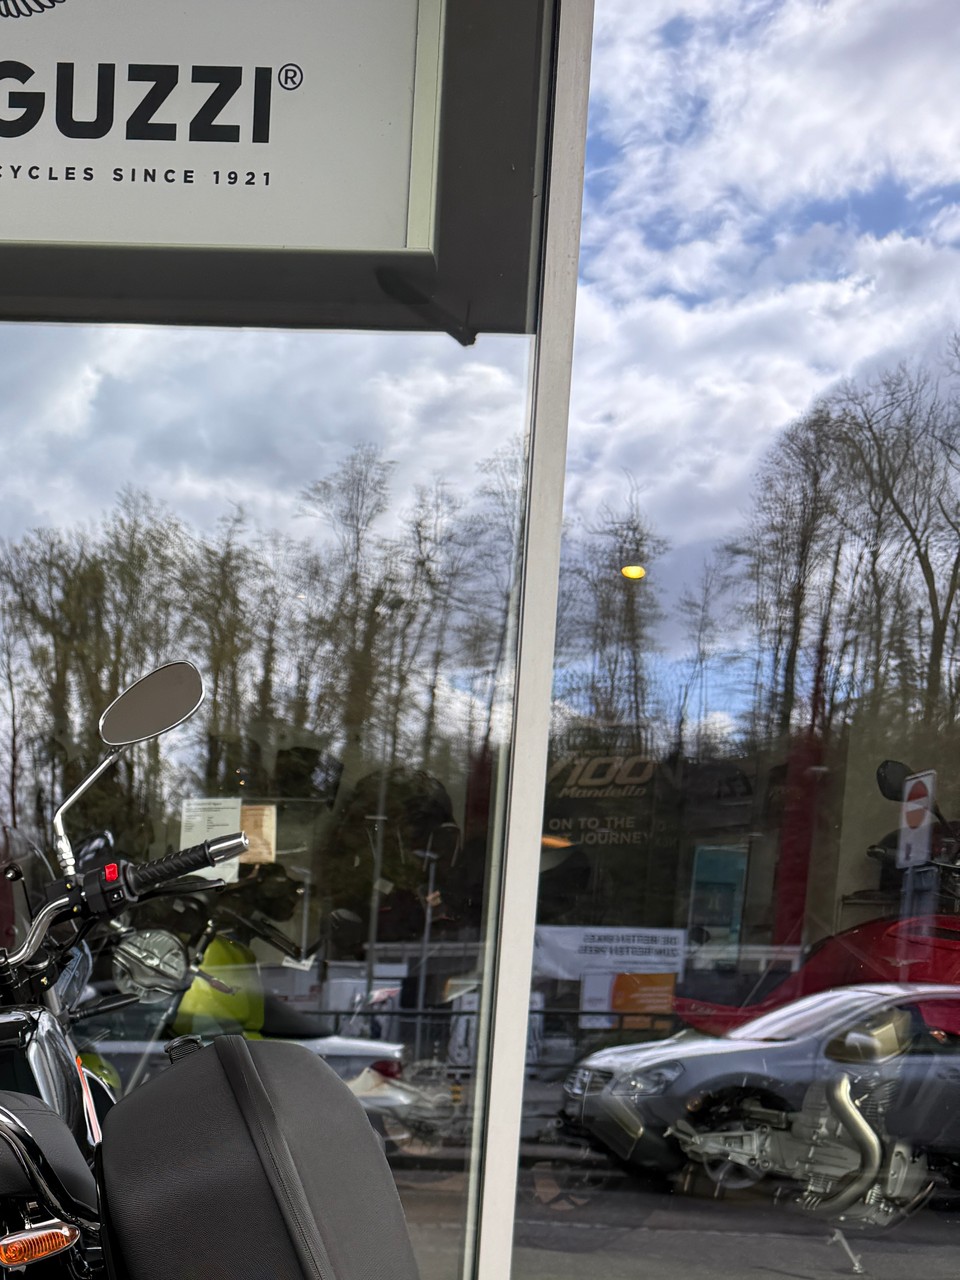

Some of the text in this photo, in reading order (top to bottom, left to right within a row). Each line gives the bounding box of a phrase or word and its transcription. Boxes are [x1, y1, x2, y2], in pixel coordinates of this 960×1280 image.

[113, 168, 195, 184] SINCE
[213, 170, 270, 186] 1921
[548, 818, 573, 831] ON
[578, 817, 600, 830] TO
